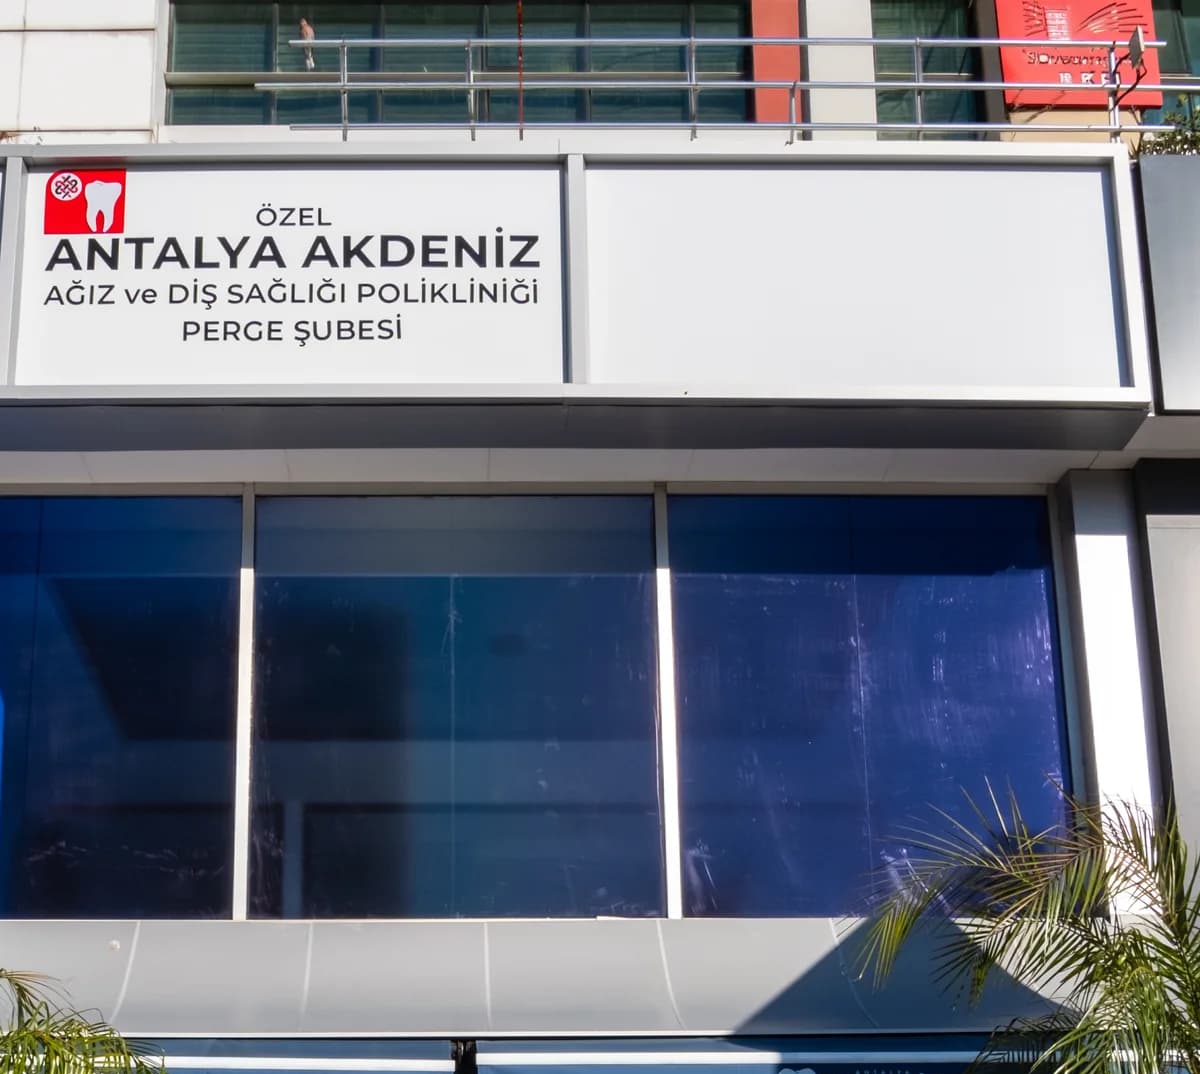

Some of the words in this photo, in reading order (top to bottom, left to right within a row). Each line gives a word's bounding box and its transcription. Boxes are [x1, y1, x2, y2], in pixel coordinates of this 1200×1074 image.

[256, 203, 332, 227] ÖZEL
[45, 236, 287, 272] ANTALYA
[301, 226, 540, 268] AKDENİZ
[43, 279, 115, 306] AĞIZ
[124, 288, 158, 305] ve
[168, 278, 217, 311] DİŞ
[227, 277, 345, 304] SAĞLIĞI
[357, 277, 538, 305] POLİKLİNİĞİ
[183, 320, 283, 342] PERGE
[294, 313, 402, 347] ŞUBESİ
